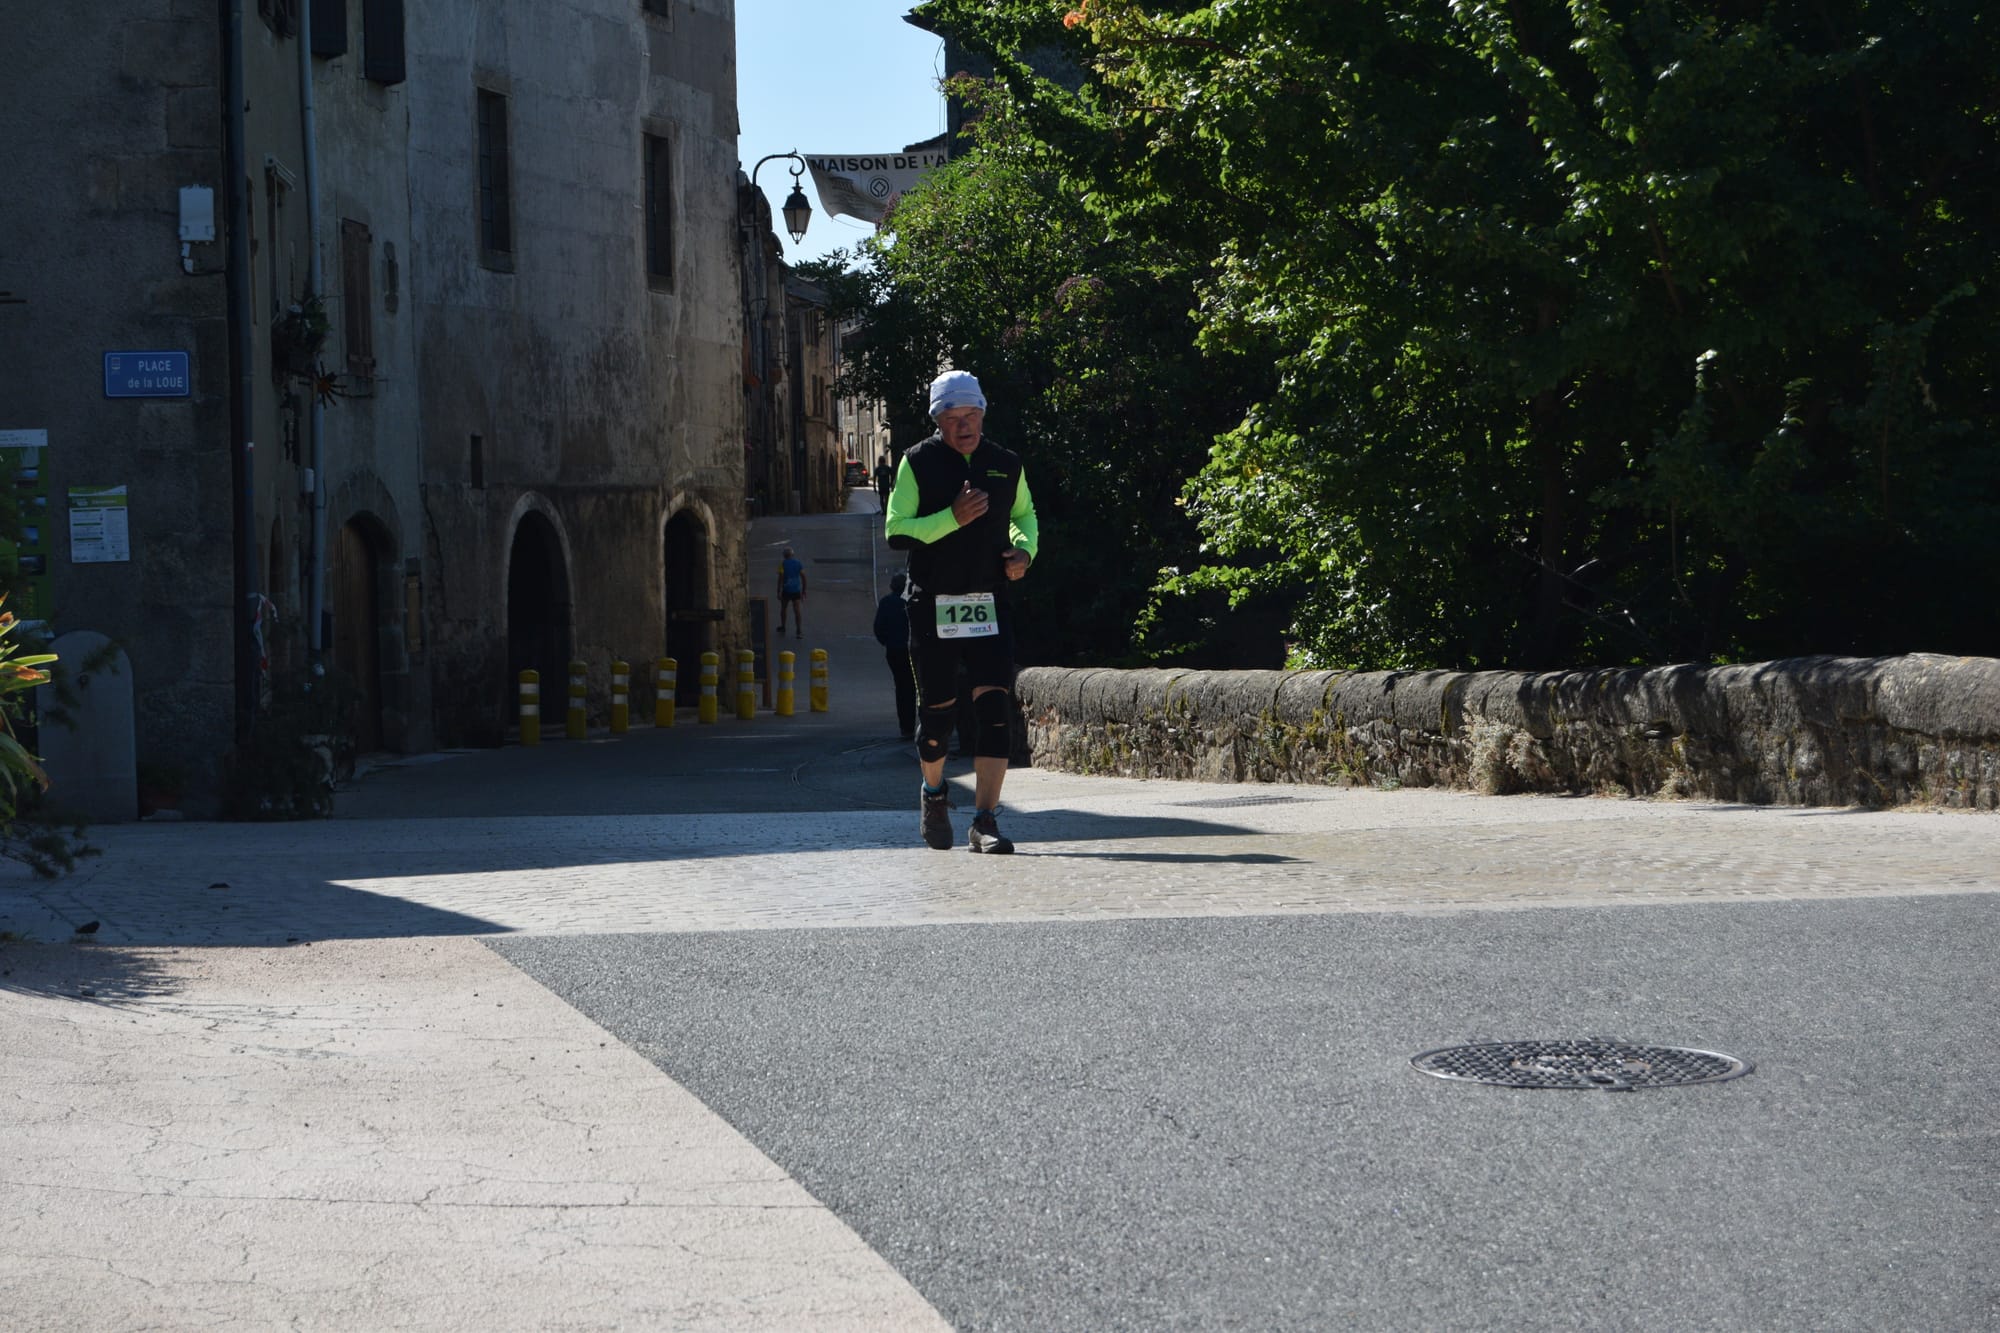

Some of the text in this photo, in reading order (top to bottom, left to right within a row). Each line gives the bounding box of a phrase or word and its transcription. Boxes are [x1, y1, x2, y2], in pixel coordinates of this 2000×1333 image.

[810, 157, 887, 172] MAISON
[894, 155, 918, 169] DE
[138, 360, 172, 371] PLACE
[127, 376, 183, 388] de la LOUE
[946, 605, 988, 623] 126
